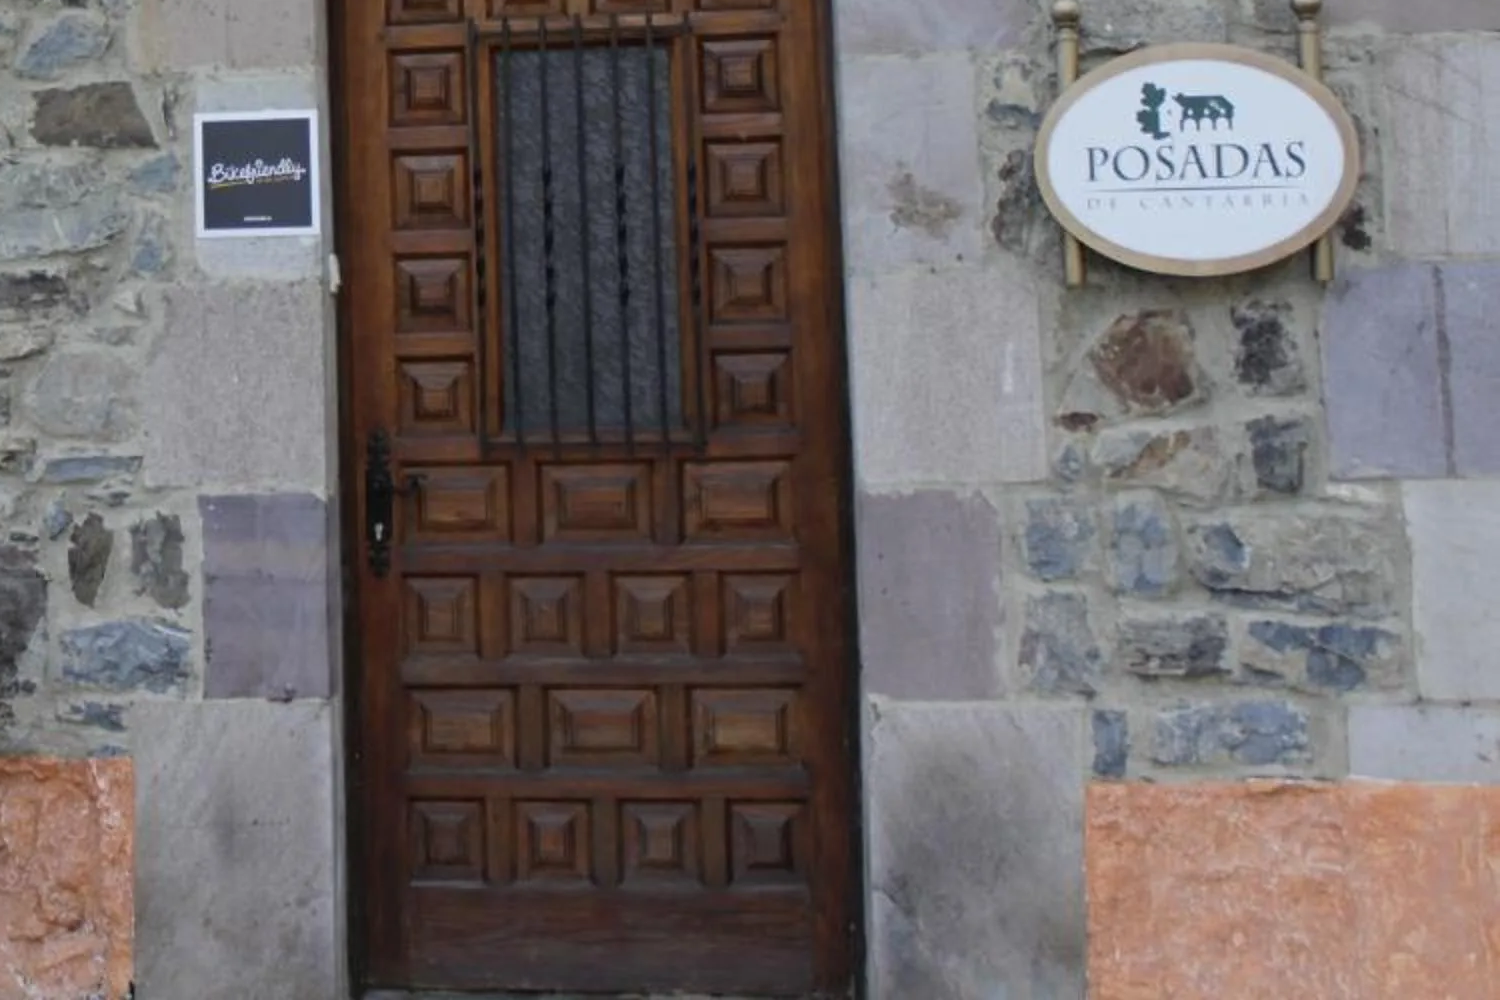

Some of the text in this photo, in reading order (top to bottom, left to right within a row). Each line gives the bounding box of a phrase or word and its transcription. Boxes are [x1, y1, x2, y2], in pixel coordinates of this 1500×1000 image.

[1085, 141, 1307, 182] POSADAS
[1086, 192, 1310, 211] DE CANTABRIA
